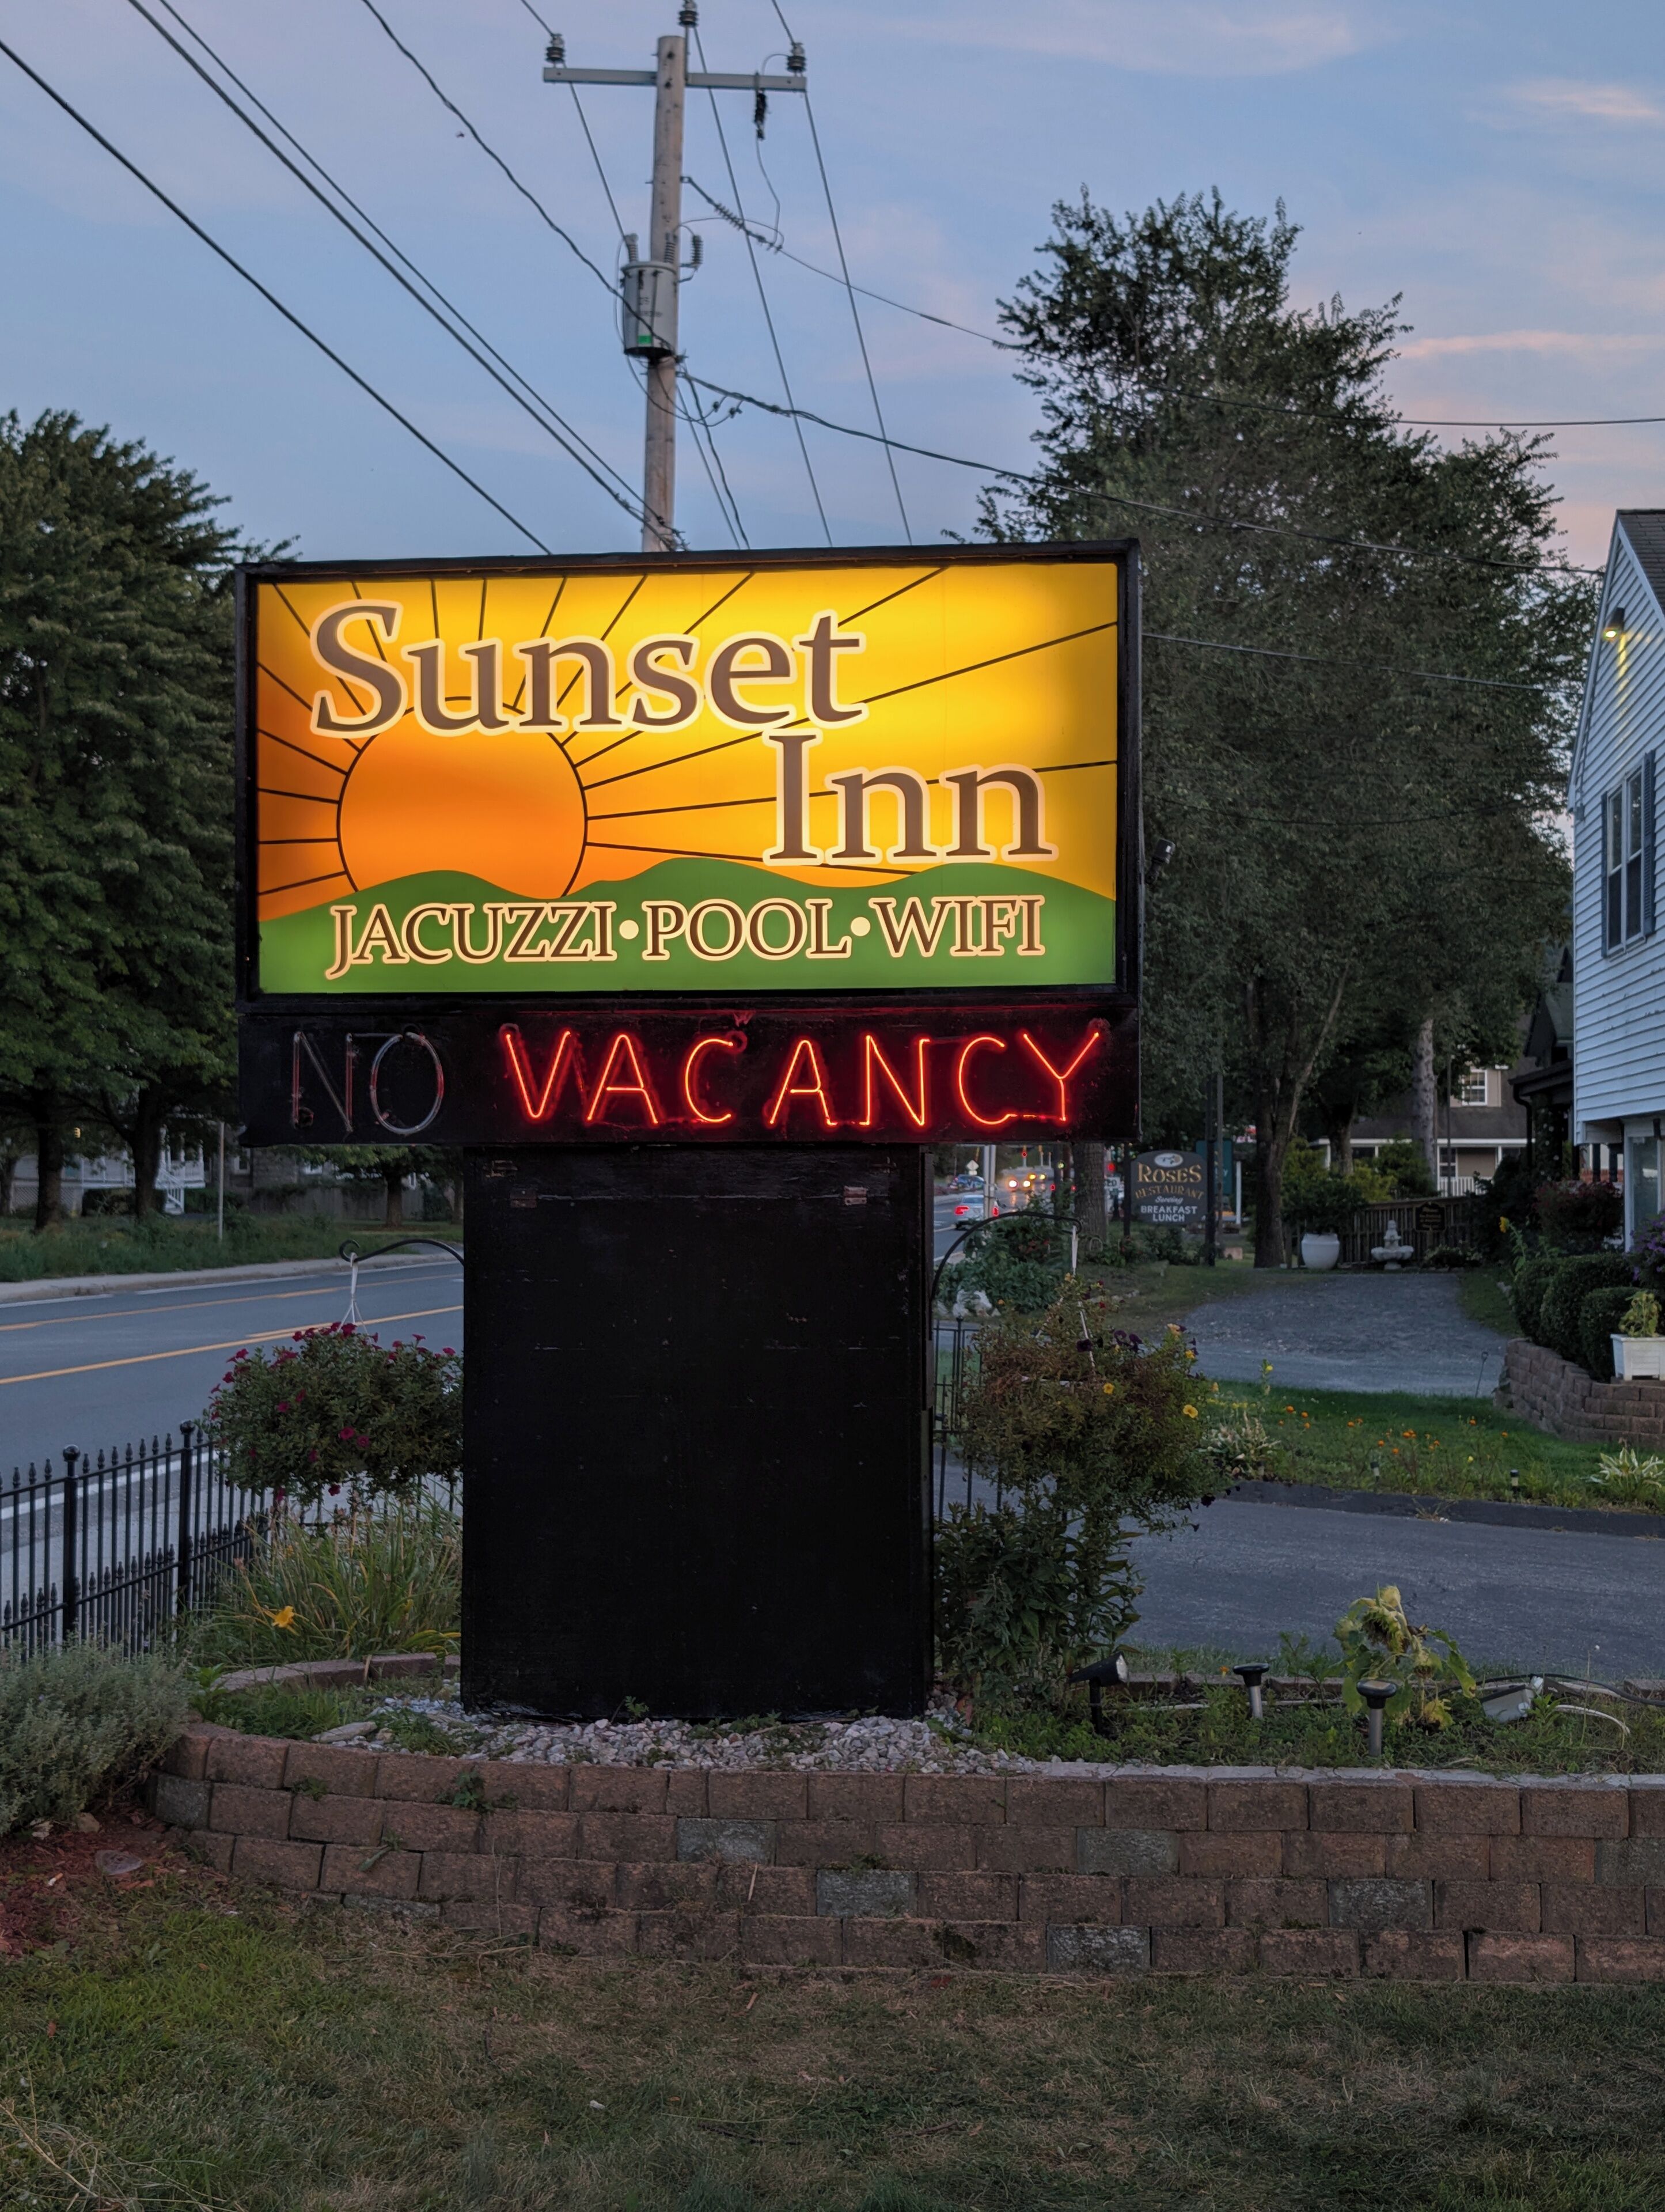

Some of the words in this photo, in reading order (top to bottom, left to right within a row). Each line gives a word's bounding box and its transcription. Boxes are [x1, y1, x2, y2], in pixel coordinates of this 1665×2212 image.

[312, 601, 868, 734] Sunset
[765, 730, 1057, 866] Inn
[326, 900, 617, 980] JACUZZI
[642, 897, 852, 960] POOL
[868, 894, 1045, 957] WIFI
[291, 1030, 445, 1134] NO
[503, 1030, 1100, 1127] VACANCY
[1137, 1162, 1202, 1183] ROSES
[1135, 1184, 1204, 1200] RESTAURANT
[1155, 1195, 1184, 1205] Serving
[1140, 1205, 1197, 1215] BREAKFAST
[1152, 1214, 1185, 1222] LUNCH
